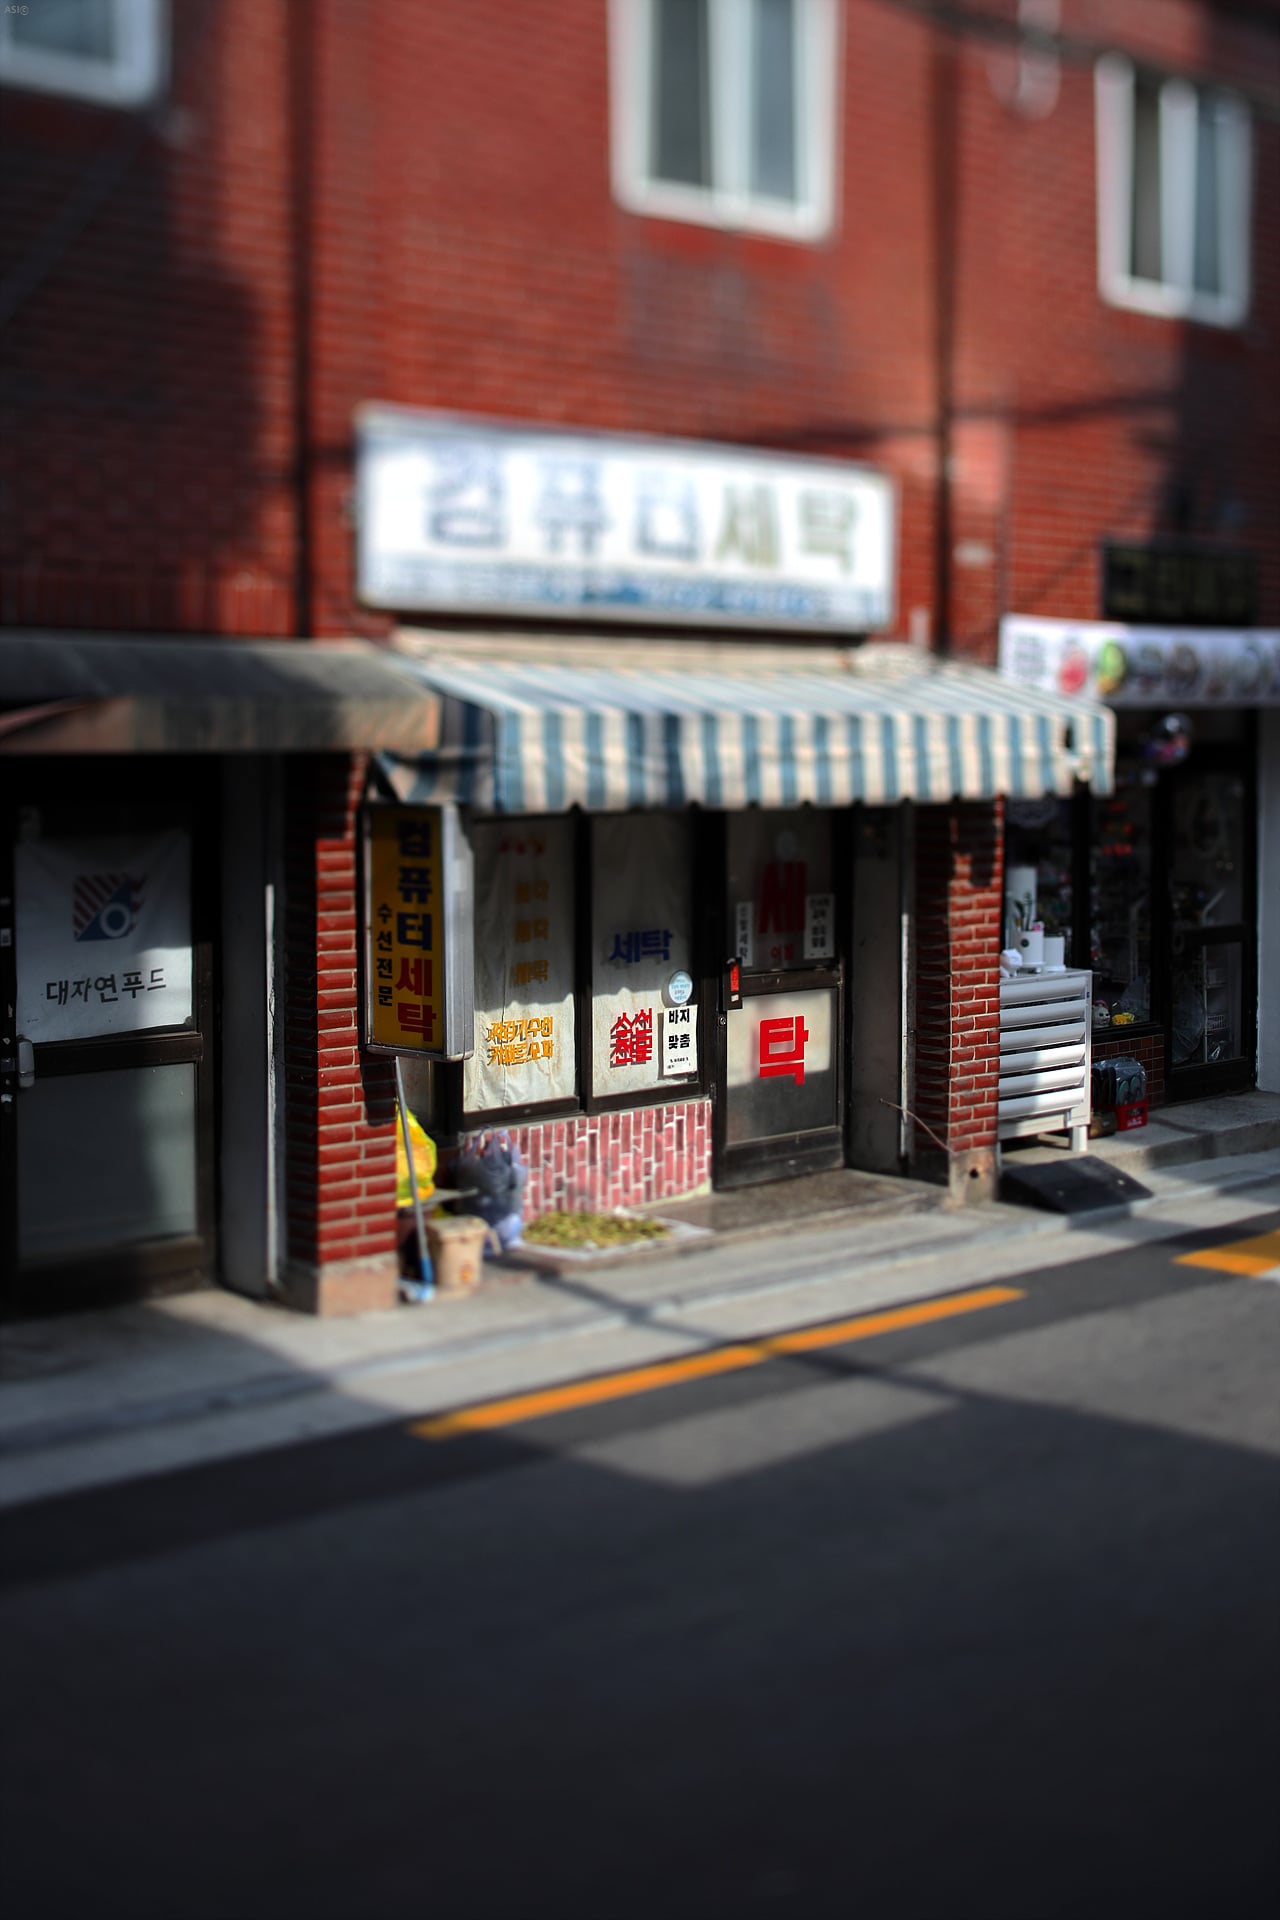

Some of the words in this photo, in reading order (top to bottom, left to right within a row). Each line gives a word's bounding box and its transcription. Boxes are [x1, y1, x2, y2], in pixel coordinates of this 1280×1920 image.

[376, 904, 393, 1006] 수선전문
[609, 929, 673, 964] 세탁
[46, 967, 167, 1006] 대자연푸드
[668, 1008, 690, 1025] 바지
[668, 1033, 691, 1050] 맞춤
